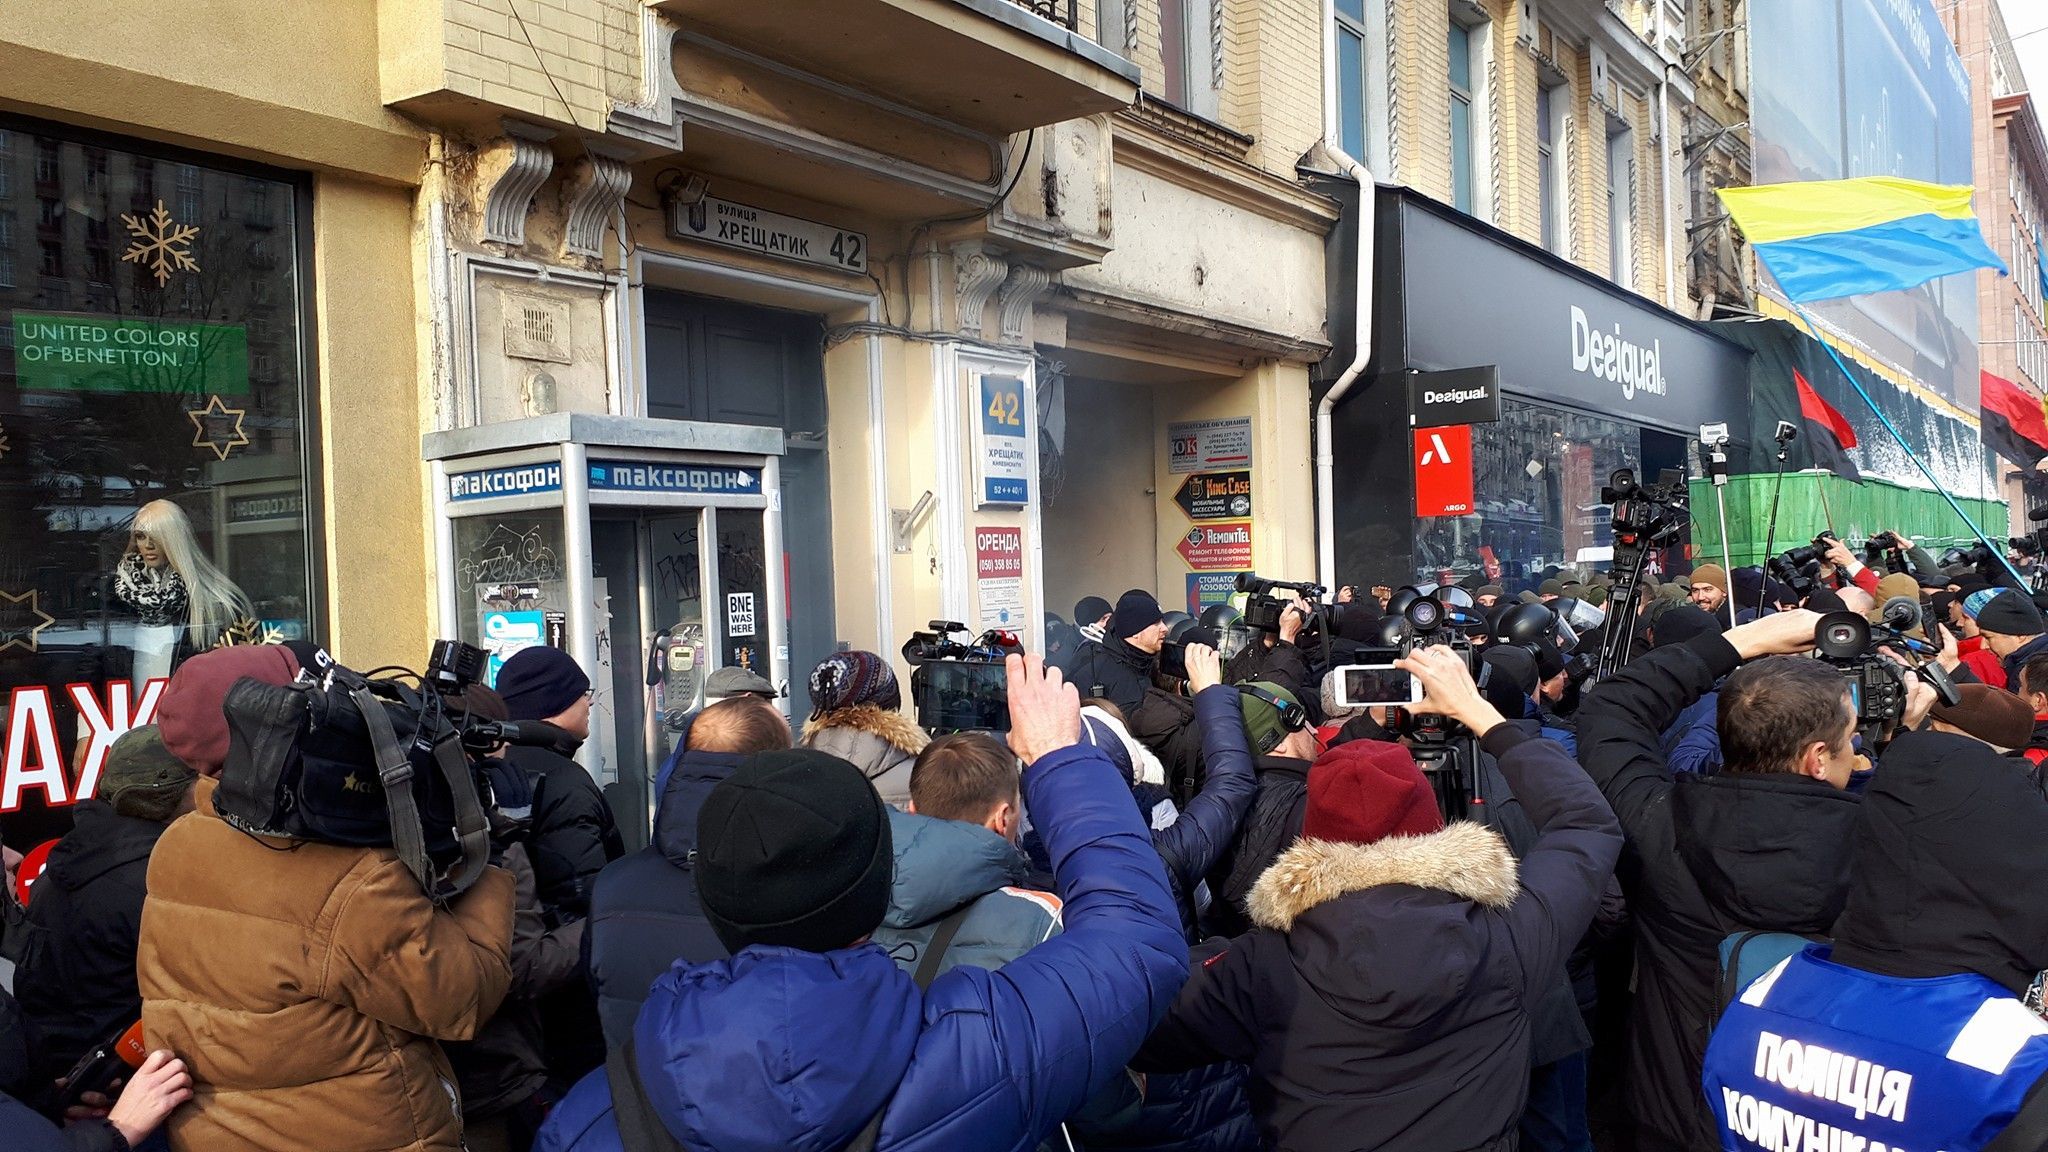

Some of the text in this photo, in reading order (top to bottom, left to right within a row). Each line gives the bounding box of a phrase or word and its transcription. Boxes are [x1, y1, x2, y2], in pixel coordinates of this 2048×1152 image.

[717, 203, 757, 223] ВУЛИЦЯ
[718, 219, 862, 268] ХРЕЩАТИК 42
[21, 322, 200, 348] UNITED COLORS
[23, 344, 183, 367] OF BENETTON.
[1570, 304, 1662, 400] Desigual
[1424, 386, 1485, 404] Desigual
[988, 391, 1020, 426] 42
[988, 449, 1024, 461] ХРЕЩАТИК
[1443, 503, 1466, 511] ARGO
[977, 533, 1020, 554] ОРЕНДА
[1188, 547, 1251, 556] РЕМОНТ ТЕЛЕФОНОВ
[979, 559, 994, 573] (050)
[730, 596, 752, 613] BNE
[731, 613, 752, 623] WAS
[731, 624, 753, 634] HERE
[1754, 1031, 1913, 1123] ПОЛІЦІЯ
